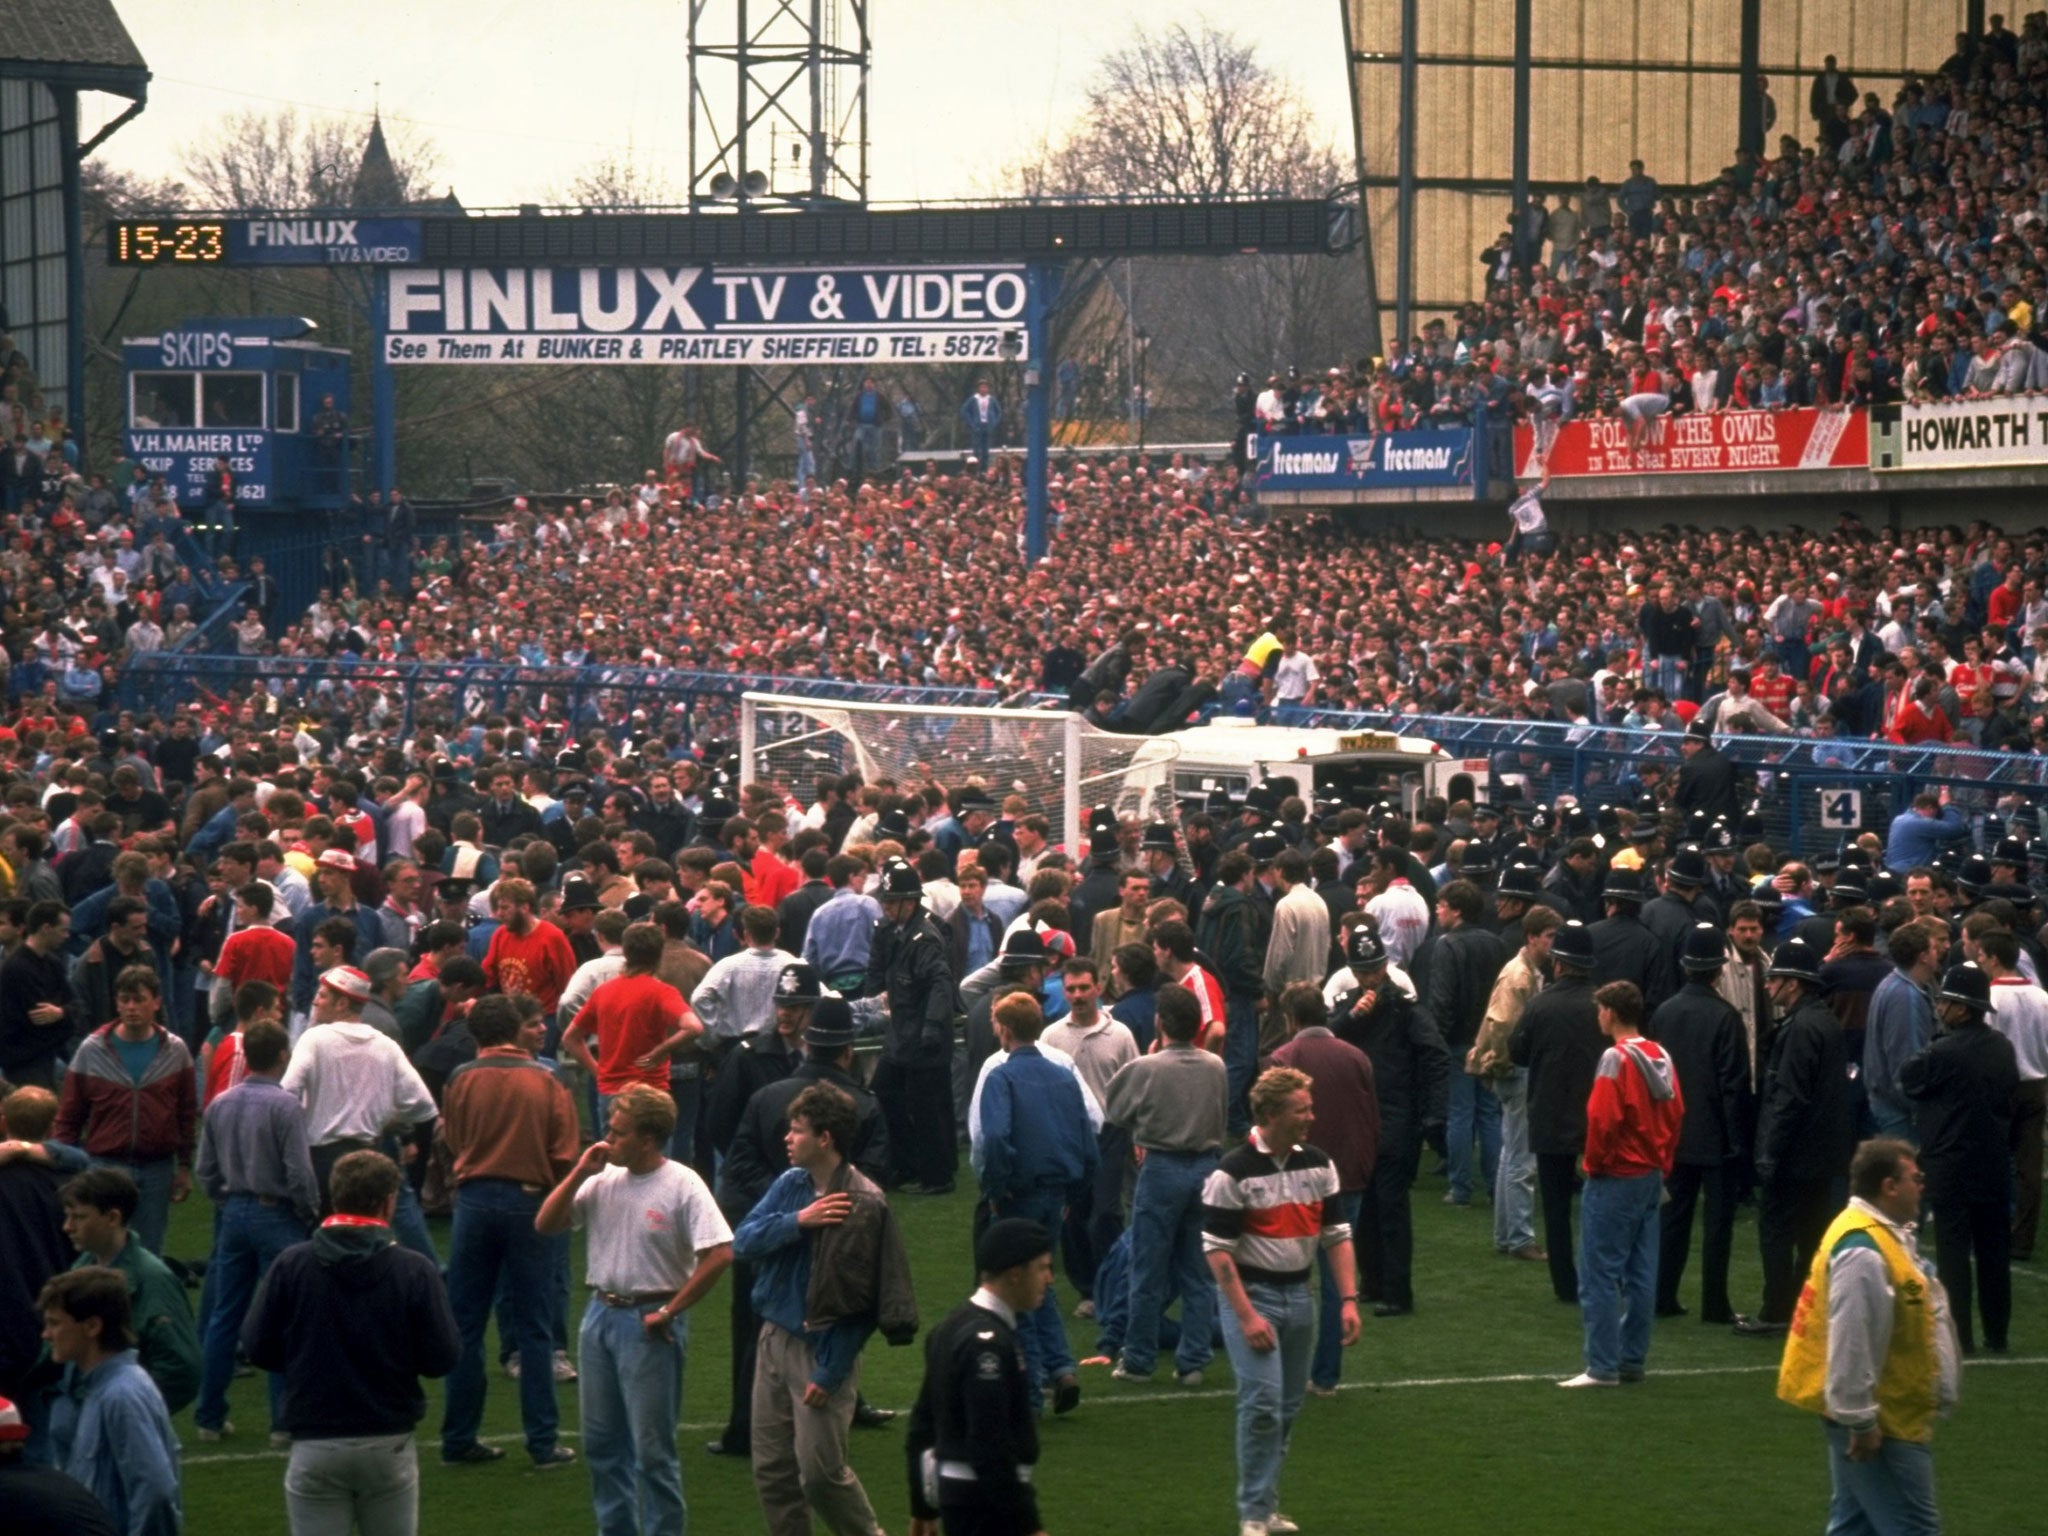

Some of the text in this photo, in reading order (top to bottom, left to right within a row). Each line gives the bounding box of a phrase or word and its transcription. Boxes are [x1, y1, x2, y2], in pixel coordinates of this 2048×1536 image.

[120, 226, 222, 259] 15-23
[249, 220, 358, 246] FINLUX
[328, 247, 409, 262] TV & VIDEO
[388, 267, 707, 332] FINLUX
[712, 273, 1027, 320] TV & VIDEO
[161, 332, 232, 367] SKIPS
[388, 338, 427, 359] See
[438, 337, 492, 359] Them
[501, 338, 525, 359] At
[537, 338, 622, 359] BUNKER
[629, 338, 644, 358] &
[659, 336, 752, 359] PRATLEY
[762, 336, 878, 358] SHEFFIELD
[1674, 416, 1713, 446] THE
[1722, 413, 1776, 444] OWLS
[1907, 412, 2029, 452] HOWARTH
[141, 457, 254, 472] SKIP SERCES
[1636, 449, 1666, 469] Star
[1670, 446, 1722, 468] EVERY
[1727, 444, 1780, 467] NIGHT
[1826, 792, 1857, 826] 4
